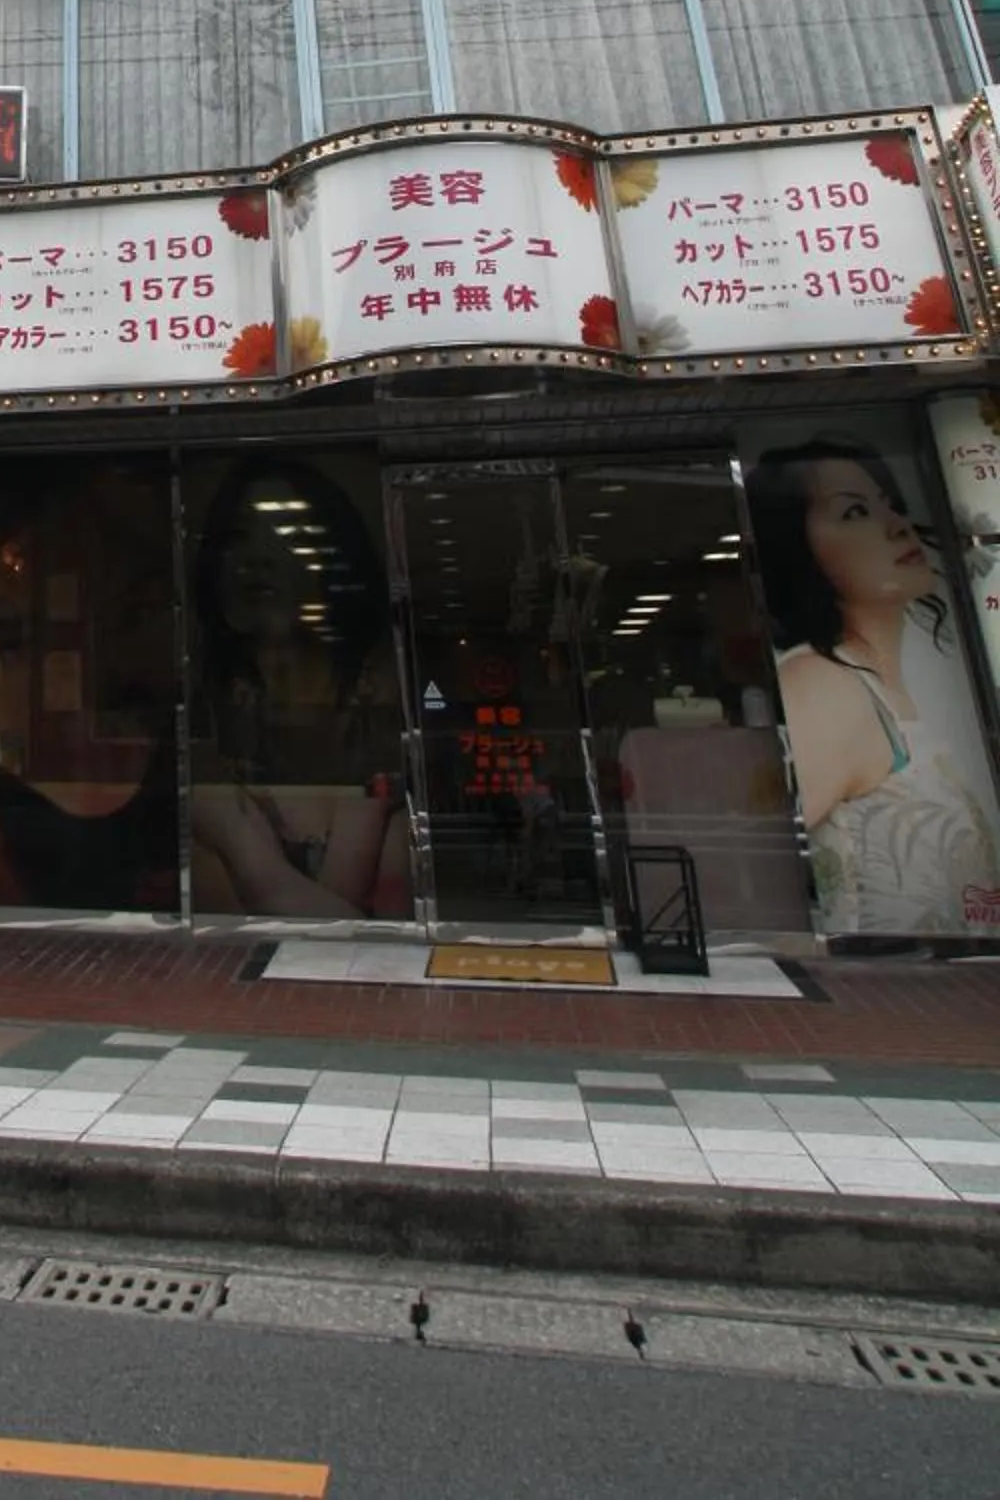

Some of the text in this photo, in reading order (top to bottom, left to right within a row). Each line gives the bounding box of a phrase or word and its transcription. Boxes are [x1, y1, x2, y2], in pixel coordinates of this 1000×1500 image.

[389, 170, 485, 211] 美容
[667, 181, 869, 220] パーマ 3150
[117, 235, 213, 263] 3150
[331, 227, 558, 273] プラージュ
[674, 223, 880, 263] カット 1575
[394, 259, 497, 280] 別府店
[120, 275, 214, 302] 1575
[360, 283, 539, 320] 年中無休
[682, 279, 764, 305] ヘアカラー
